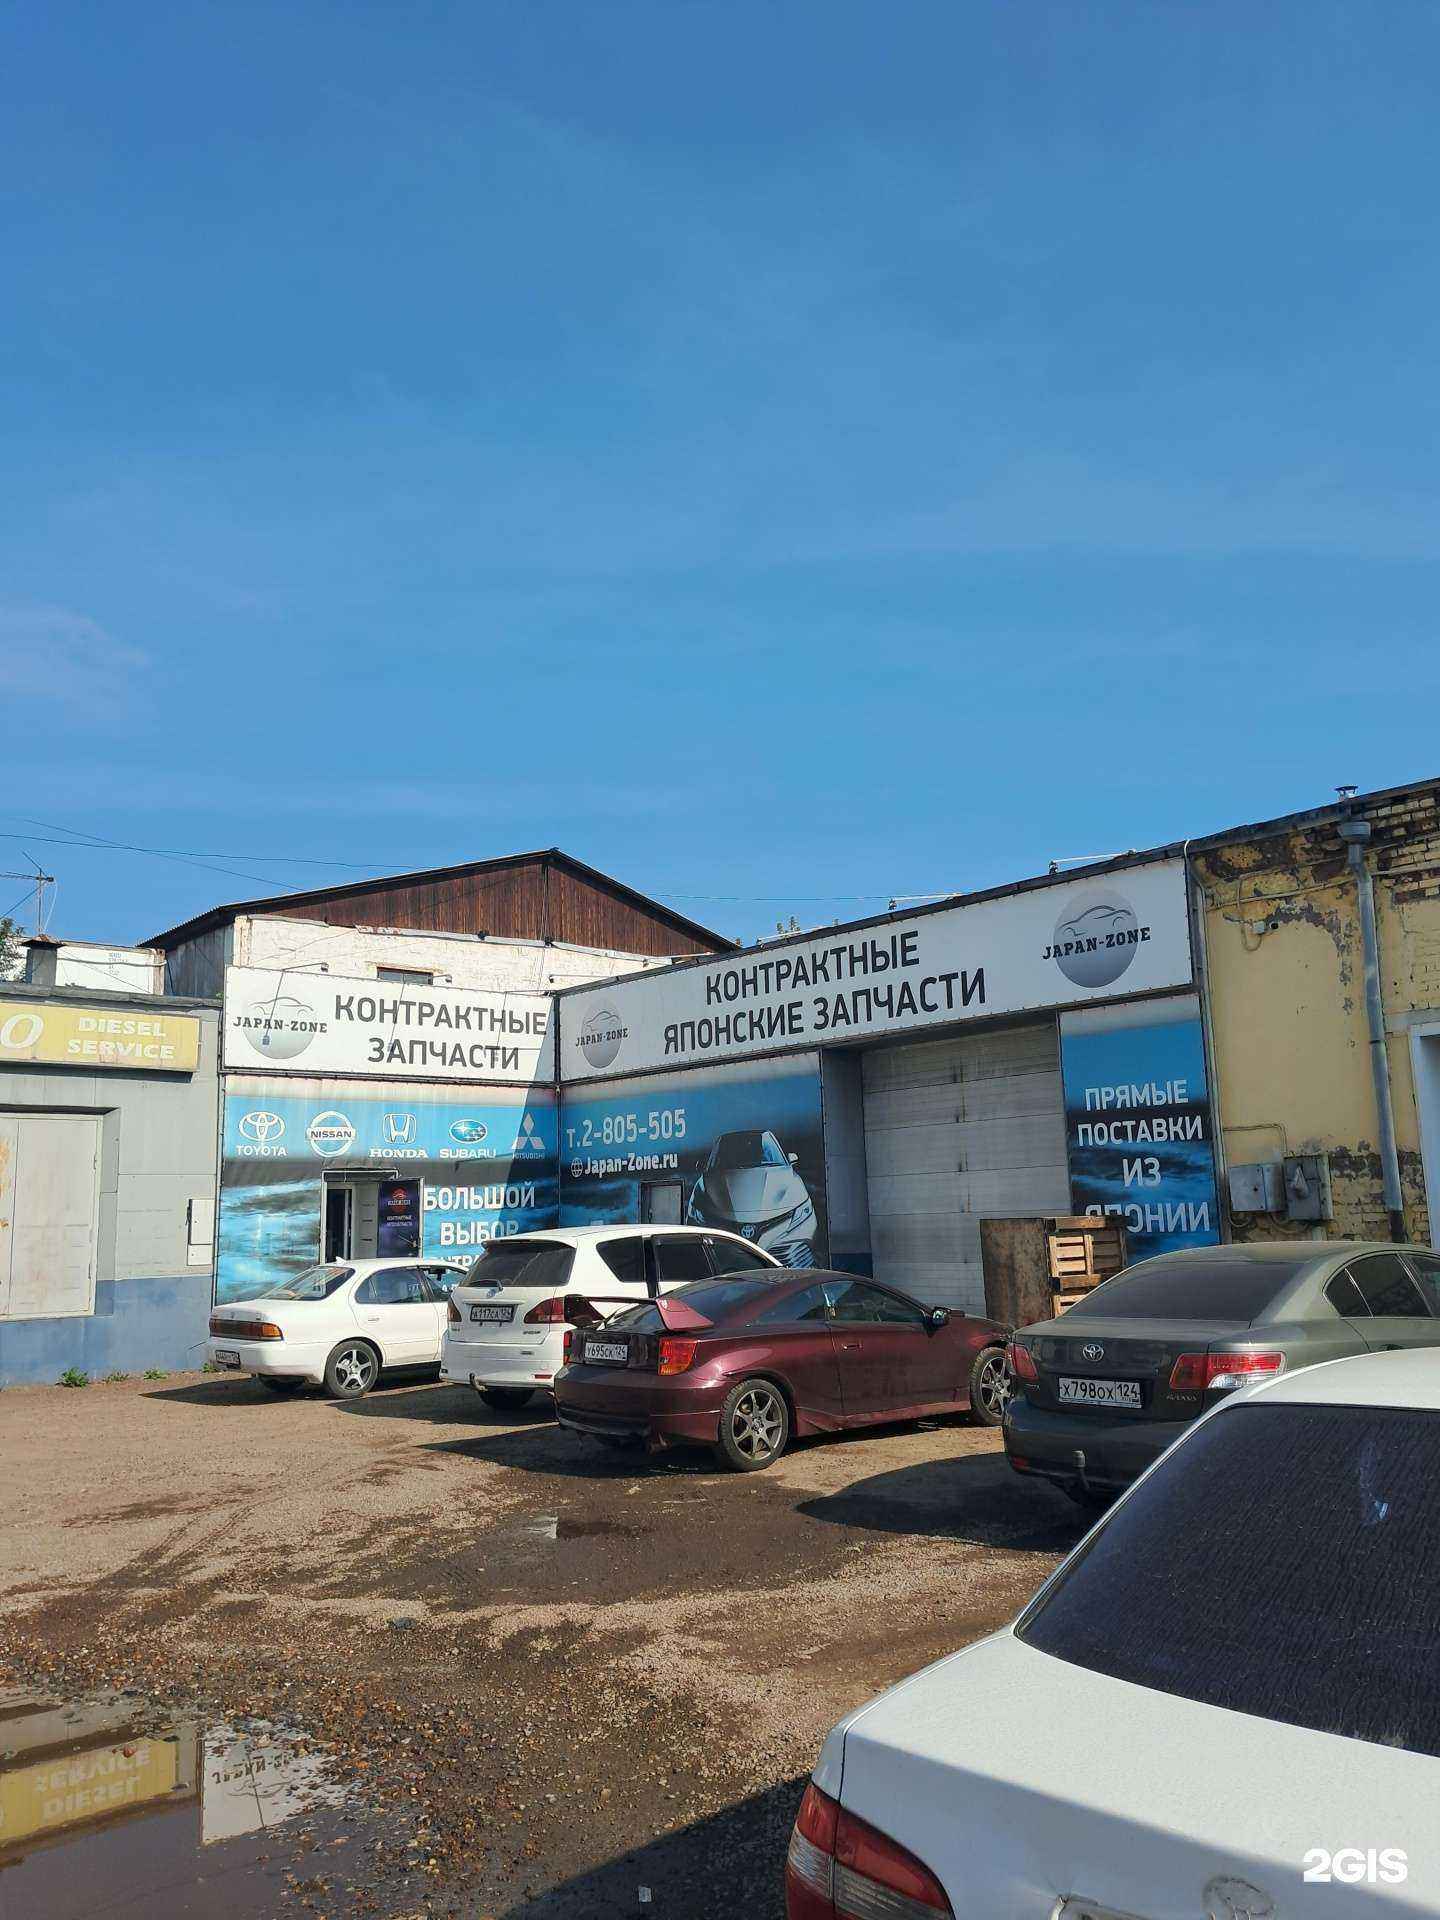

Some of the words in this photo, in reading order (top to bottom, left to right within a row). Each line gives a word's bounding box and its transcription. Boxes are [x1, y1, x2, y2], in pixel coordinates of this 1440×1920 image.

[1042, 927, 1150, 960] JAPAN-ZONE
[706, 931, 920, 1004] КОНТРАКТНЫЕ
[335, 995, 547, 1035] КОНТРАКТНЫЕ
[664, 1002, 804, 1054] ЯПОНСКИЕ
[814, 968, 986, 1030] ЗАПЧАСТИ
[79, 1017, 166, 1037] DIESEL
[233, 1016, 328, 1034] JAPAN-ZONE
[576, 1027, 629, 1047] JAPAN-ZONE
[67, 1039, 175, 1059] SERVICE
[368, 1037, 519, 1070] ЗАПЧАСТИ
[1085, 1079, 1189, 1111] ПРЯМЫЕ
[310, 1130, 352, 1138] NISSAN
[1077, 1115, 1203, 1147] ПОСТАВКИ
[236, 1145, 287, 1156] TOYOTA
[369, 1149, 428, 1158] HONDA
[439, 1148, 497, 1159] SUBARU
[584, 1152, 678, 1179] Japan-Zone.ru
[1122, 1157, 1162, 1187] ИЗ
[423, 1181, 535, 1211] БОЛЬШОЙ
[1117, 1383, 1138, 1398] 124
